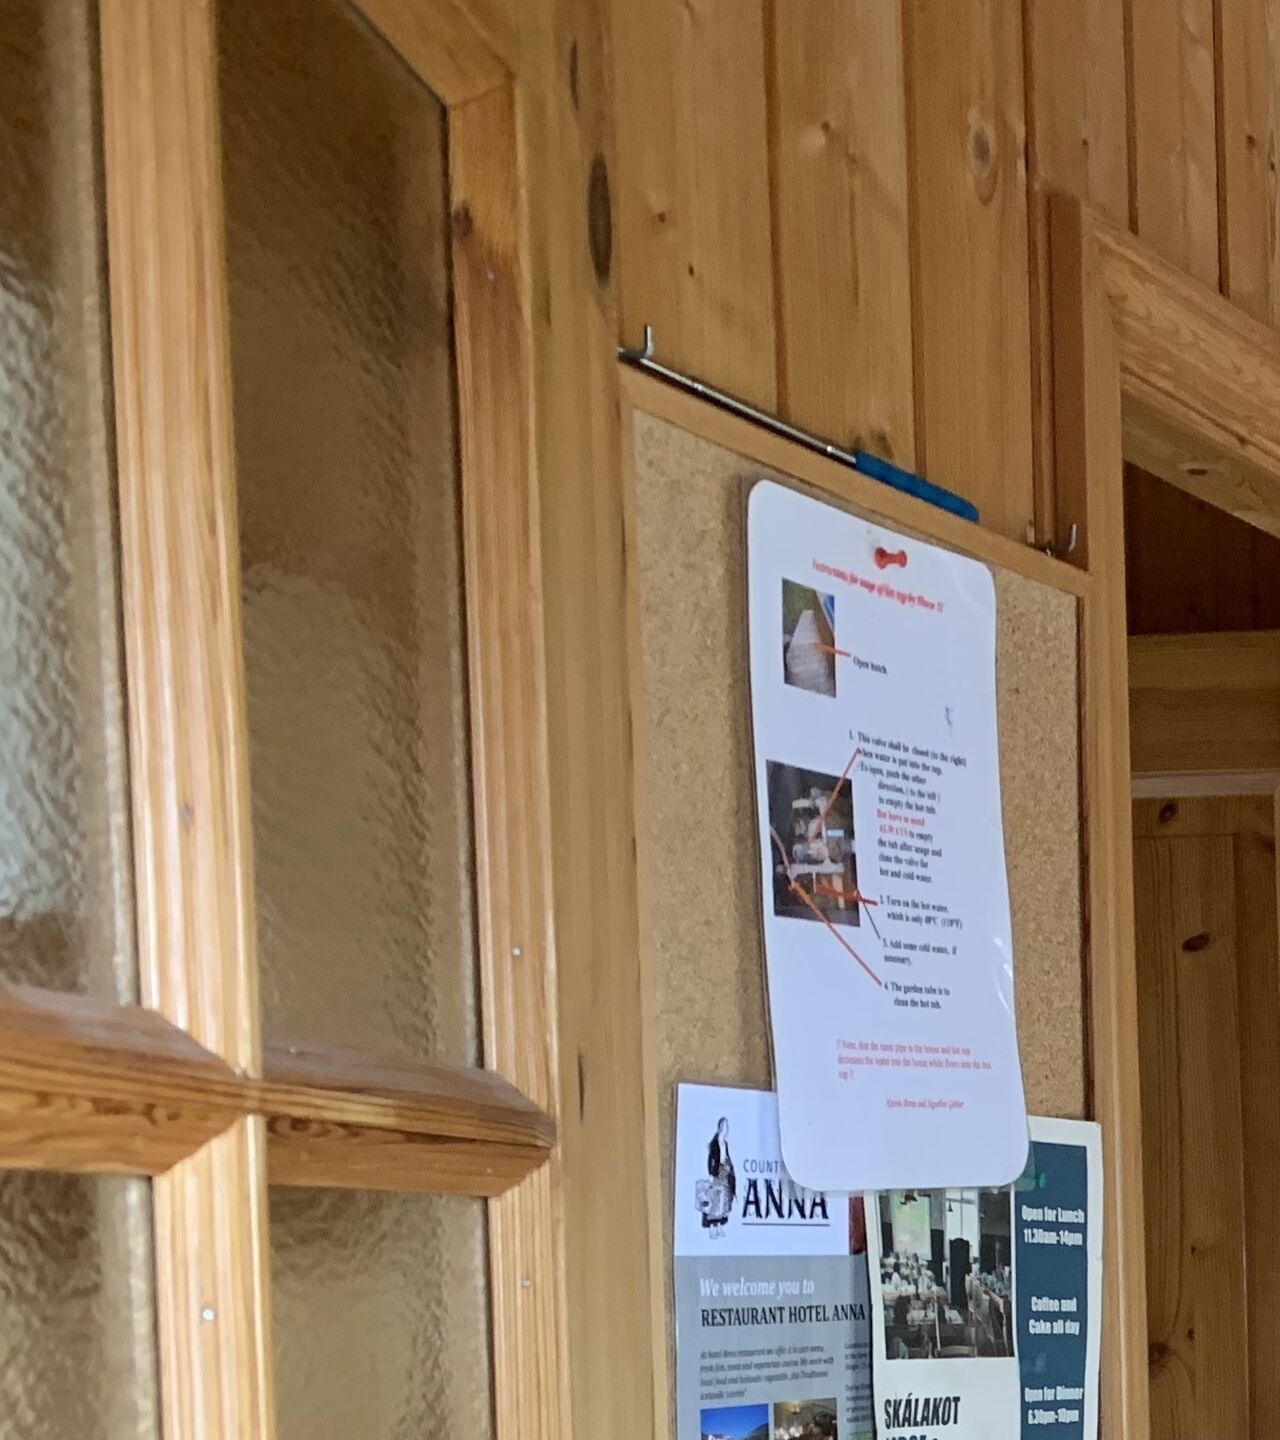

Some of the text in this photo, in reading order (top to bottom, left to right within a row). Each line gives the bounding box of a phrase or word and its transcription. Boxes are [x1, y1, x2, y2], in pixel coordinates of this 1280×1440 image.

[742, 1178, 829, 1220] ANNA
[1022, 1205, 1084, 1223] Open for Lunch
[700, 1277, 815, 1300] We welcome you to
[1031, 1296, 1078, 1312] Coffee and
[701, 1303, 866, 1328] RESTAURANT HOTEL ANNA
[1028, 1319, 1080, 1336] Cake all day
[1024, 1385, 1084, 1402] Open for Dinner
[884, 1392, 960, 1430] SKÁLAKOT
